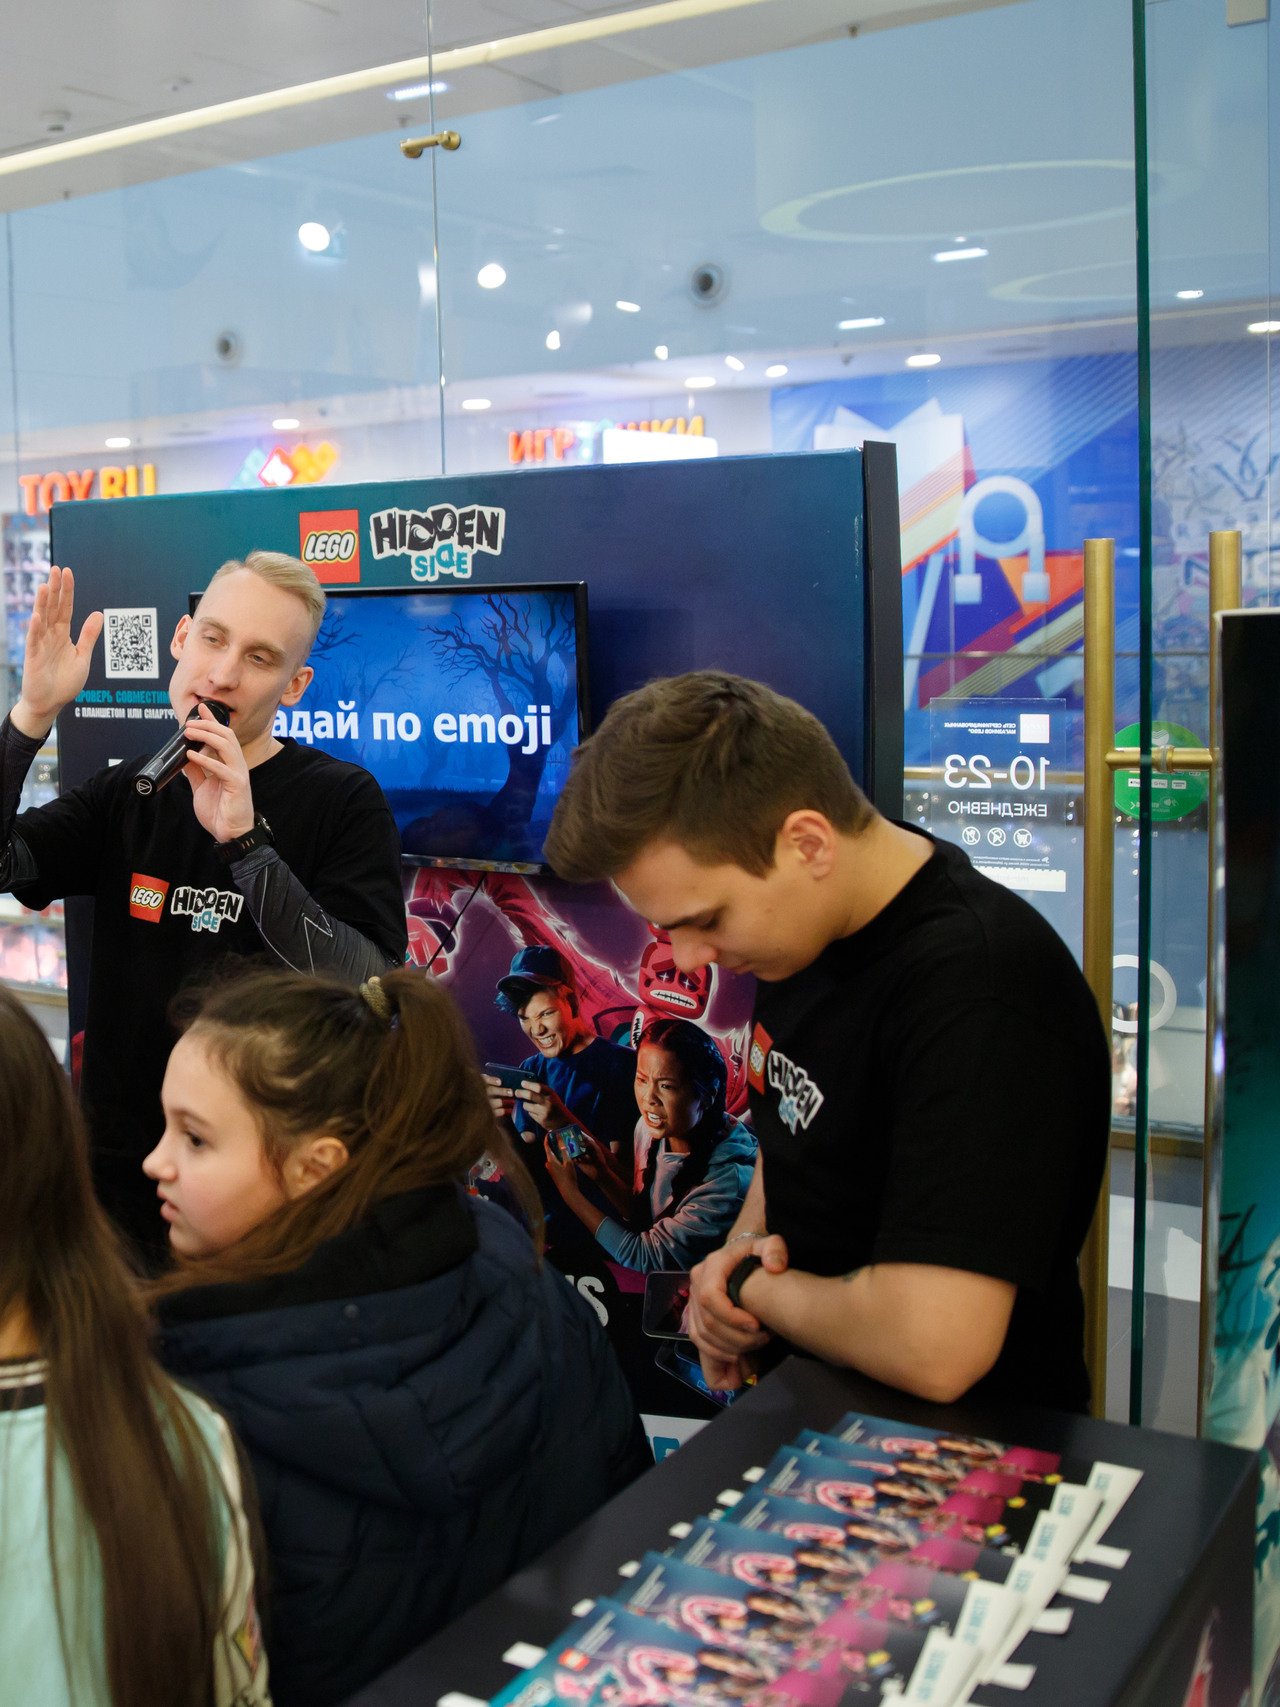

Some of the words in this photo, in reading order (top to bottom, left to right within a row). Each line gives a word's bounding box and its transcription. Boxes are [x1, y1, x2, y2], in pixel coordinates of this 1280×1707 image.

[19, 468, 95, 516] TOY
[303, 532, 356, 561] LEGO
[371, 505, 503, 557] HIDDEN
[414, 543, 469, 578] SIDE
[74, 706, 81, 718] С
[81, 707, 126, 719] ПЛАНШЕТОМ
[126, 708, 143, 719] ИЛИ
[373, 711, 421, 741] по
[433, 705, 552, 755] emoji
[130, 887, 165, 908] LEGO
[172, 887, 243, 919] HIDDEN
[192, 910, 220, 931] SIDE
